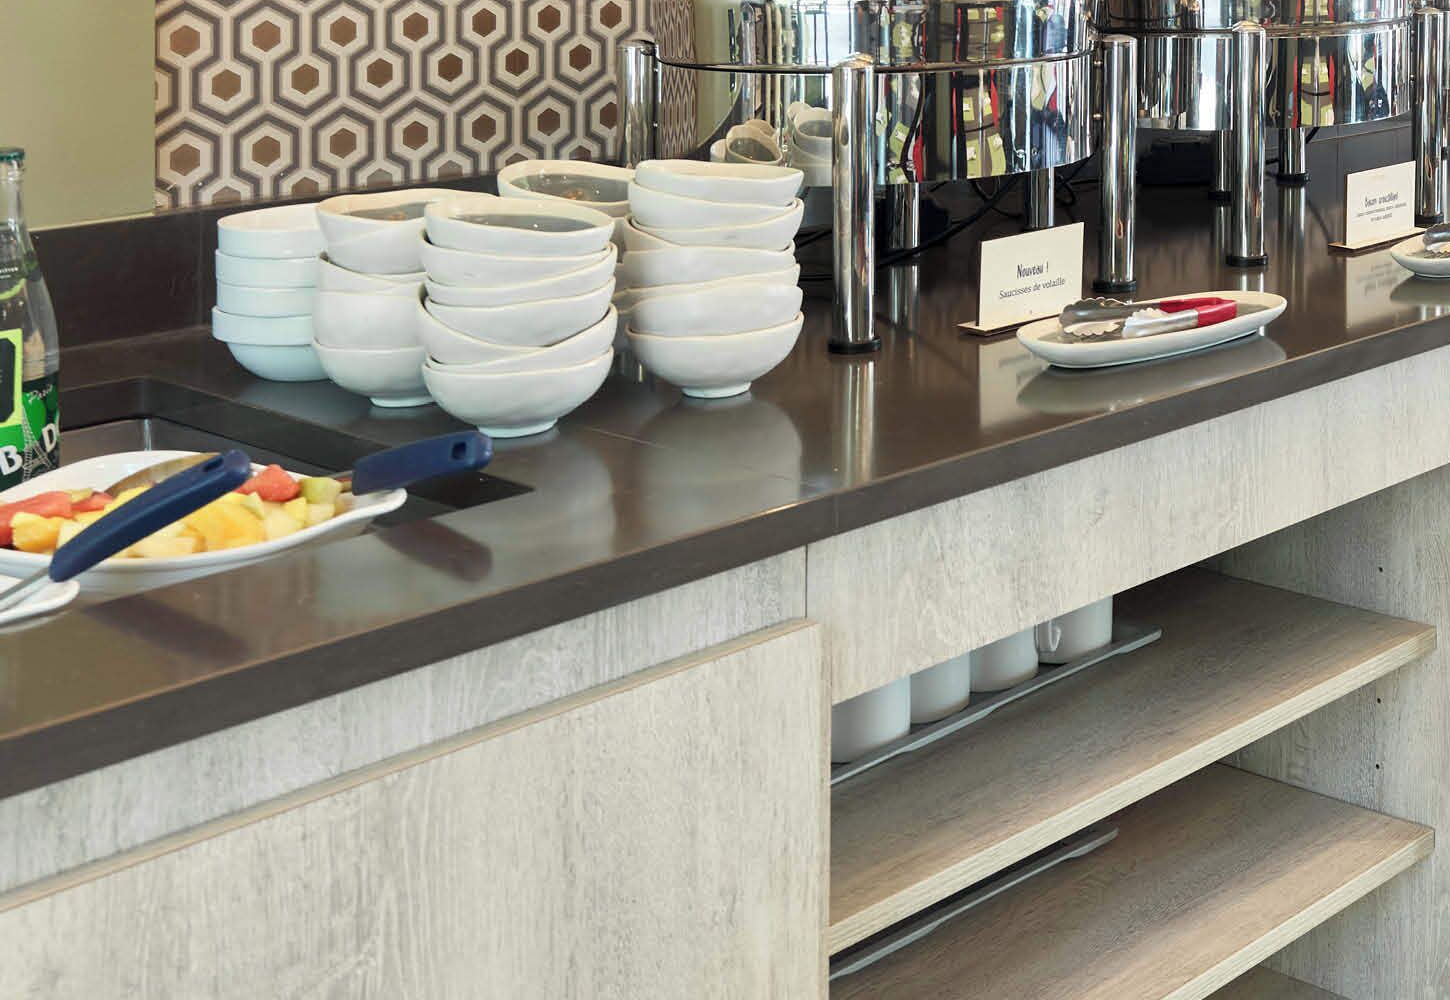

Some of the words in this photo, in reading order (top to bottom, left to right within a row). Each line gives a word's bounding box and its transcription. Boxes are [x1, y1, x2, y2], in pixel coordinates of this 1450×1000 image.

[999, 284, 1032, 299] Saucisses
[1033, 282, 1041, 291] de
[1042, 276, 1066, 289] volaille
